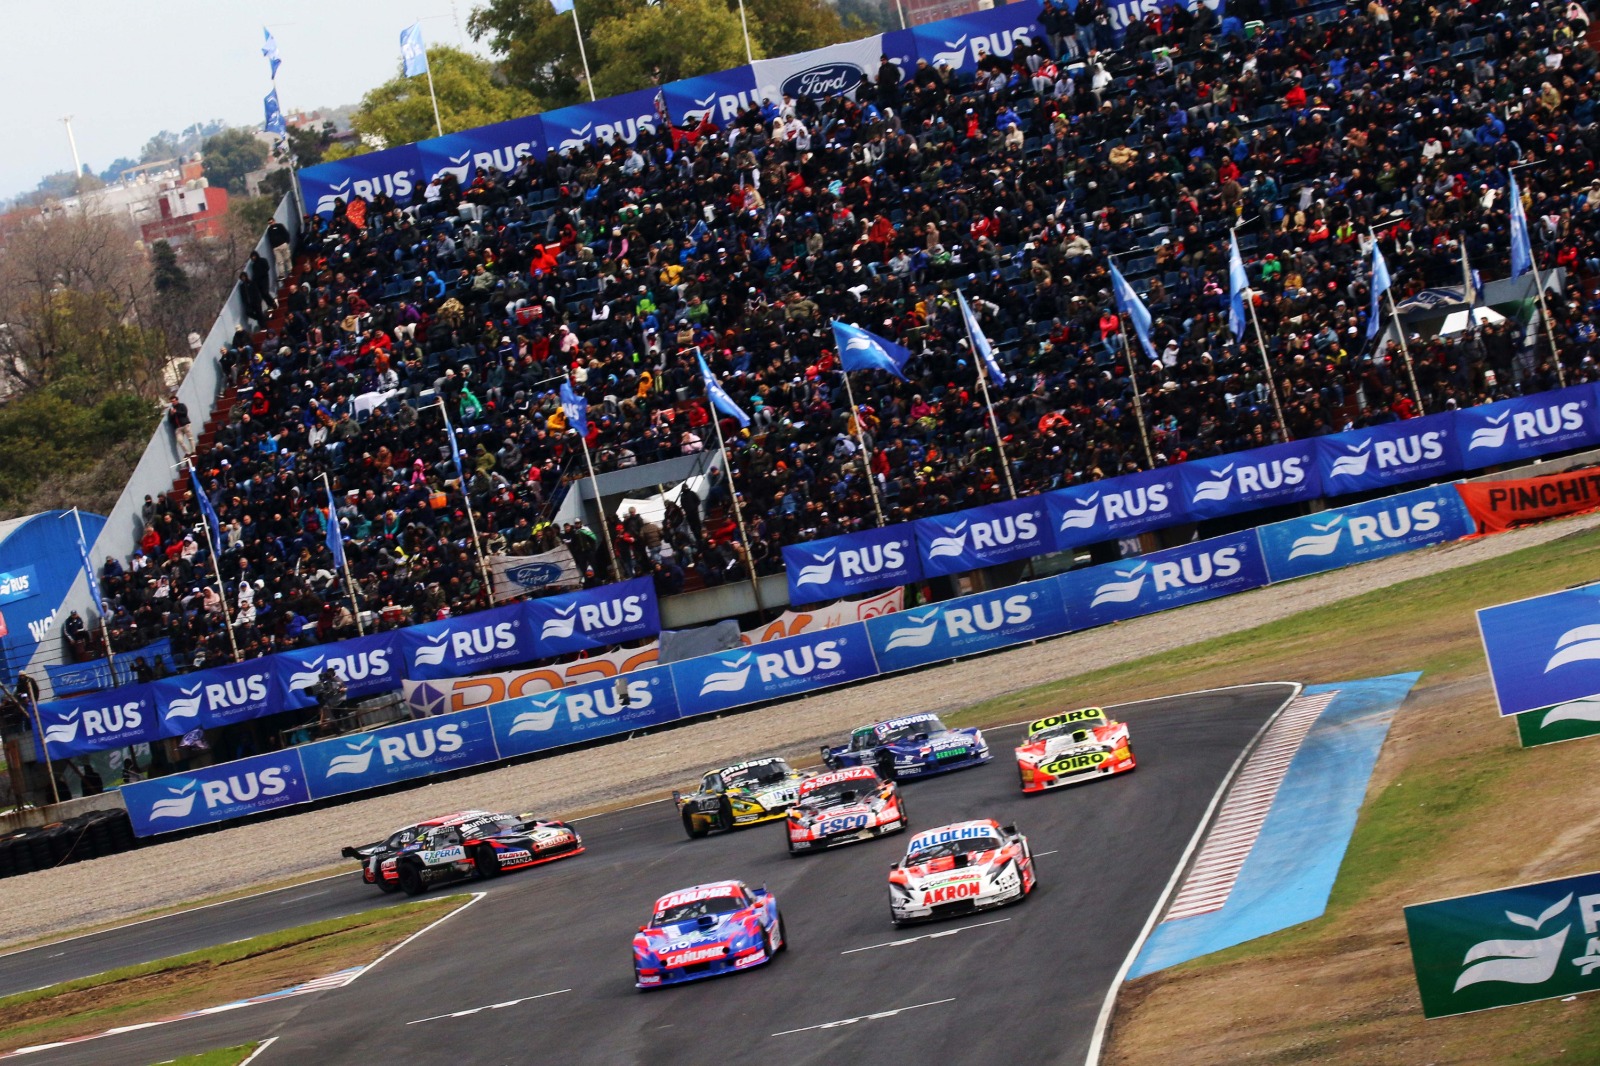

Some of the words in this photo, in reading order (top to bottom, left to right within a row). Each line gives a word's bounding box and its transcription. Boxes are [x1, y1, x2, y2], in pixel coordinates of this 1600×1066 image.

[798, 68, 847, 97] Ford
[353, 170, 412, 203] RUS
[1513, 402, 1583, 441] RUS
[1374, 431, 1443, 469] RUS
[1236, 456, 1304, 494] RUS
[1102, 484, 1168, 522] RUS
[970, 512, 1038, 550] RUS
[1348, 501, 1440, 546] RUS
[838, 541, 904, 578] RUS
[1152, 548, 1241, 592] RUS
[10, 574, 29, 592] RUS
[579, 596, 642, 632] RUS
[944, 594, 1032, 638] RUS
[452, 622, 516, 658] RUS
[326, 649, 390, 682] RUS
[756, 640, 842, 682] RUS
[206, 674, 267, 710] RUS
[565, 680, 652, 722] RUS
[82, 702, 142, 736] RUS
[890, 714, 939, 728] PROVIDUS
[1032, 708, 1100, 732] COIRO
[379, 724, 464, 766] RUS
[816, 770, 872, 787] SCIENZA
[1046, 754, 1104, 774] COIRO
[202, 768, 286, 808] RUS
[819, 814, 868, 836] ESCO
[910, 826, 991, 852] ALLOCHIS
[922, 882, 980, 906] AKRON
